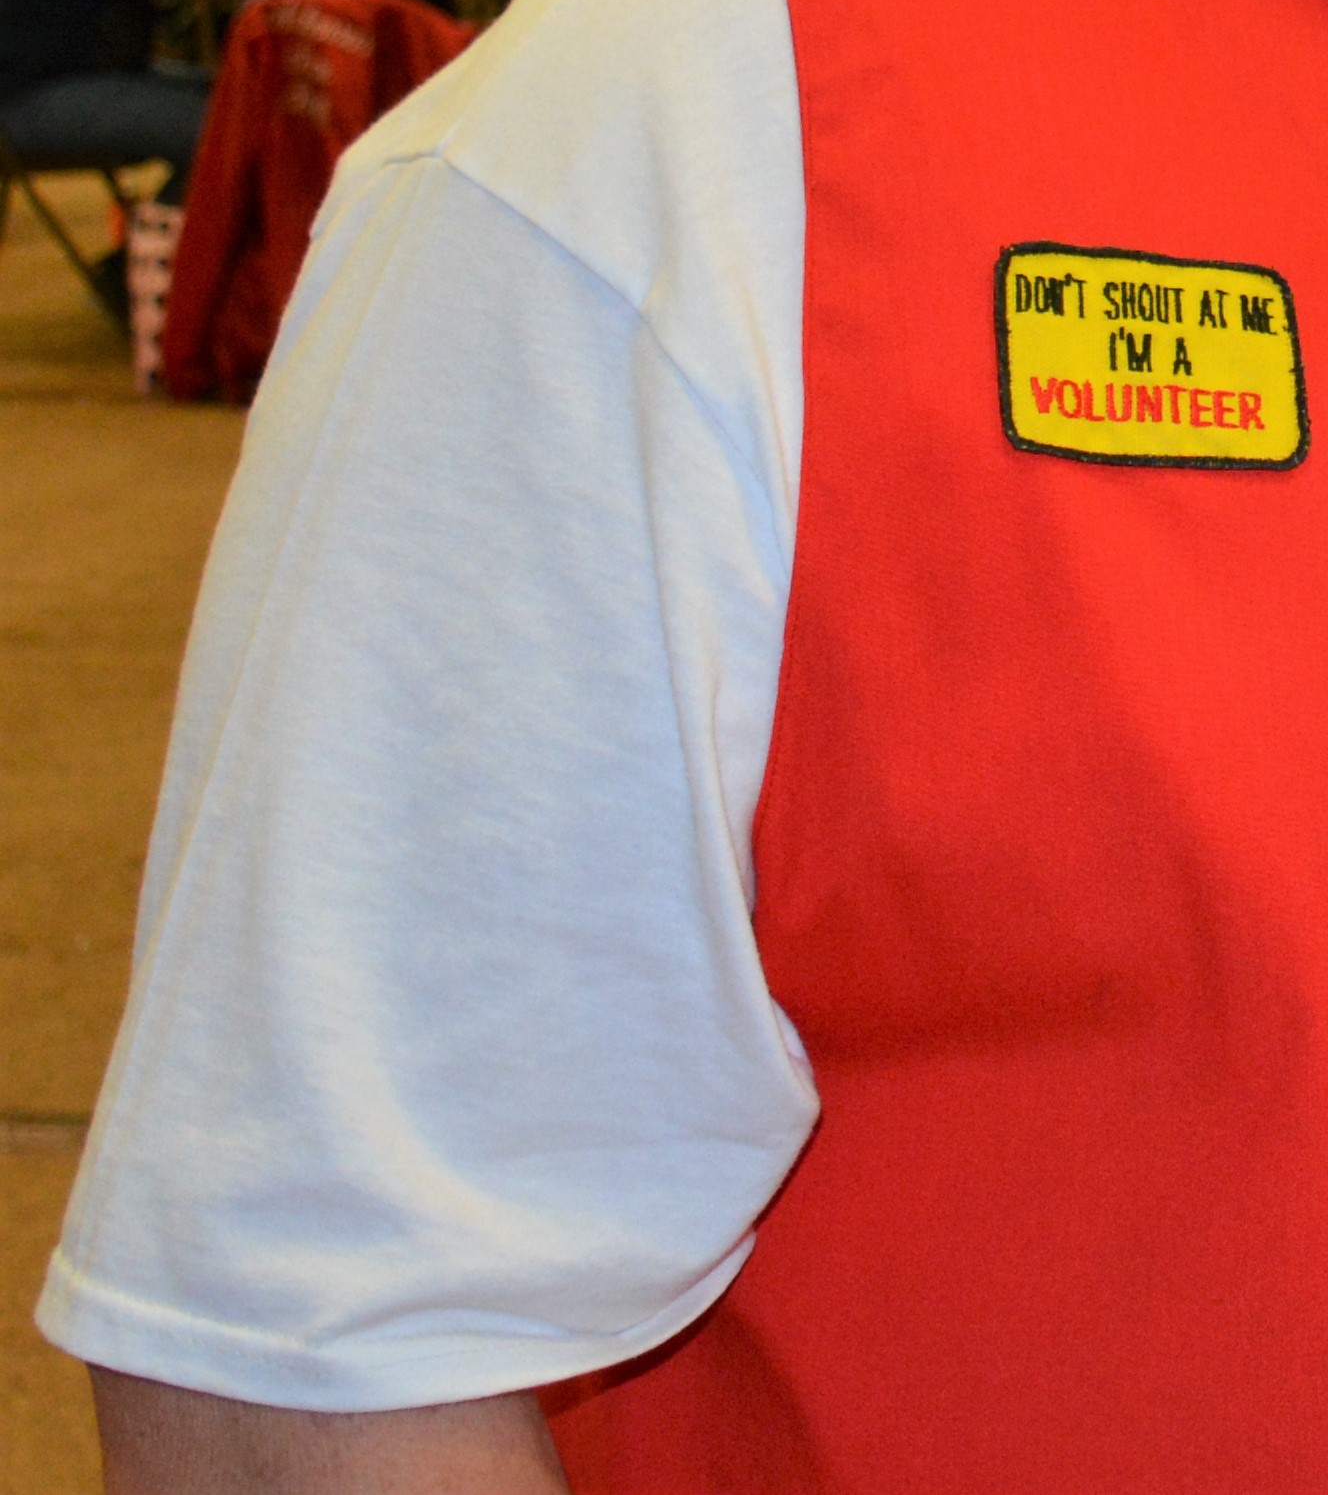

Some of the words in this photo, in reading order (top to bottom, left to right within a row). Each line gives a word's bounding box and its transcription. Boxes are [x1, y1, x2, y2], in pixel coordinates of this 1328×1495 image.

[1016, 274, 1087, 318] DON'T
[1104, 282, 1184, 324] SHOUT
[1199, 290, 1230, 329] AT
[1240, 295, 1278, 335] ME
[1108, 327, 1152, 373] I'M
[1173, 337, 1192, 376] A
[1030, 377, 1265, 430] VOLUNTEER
